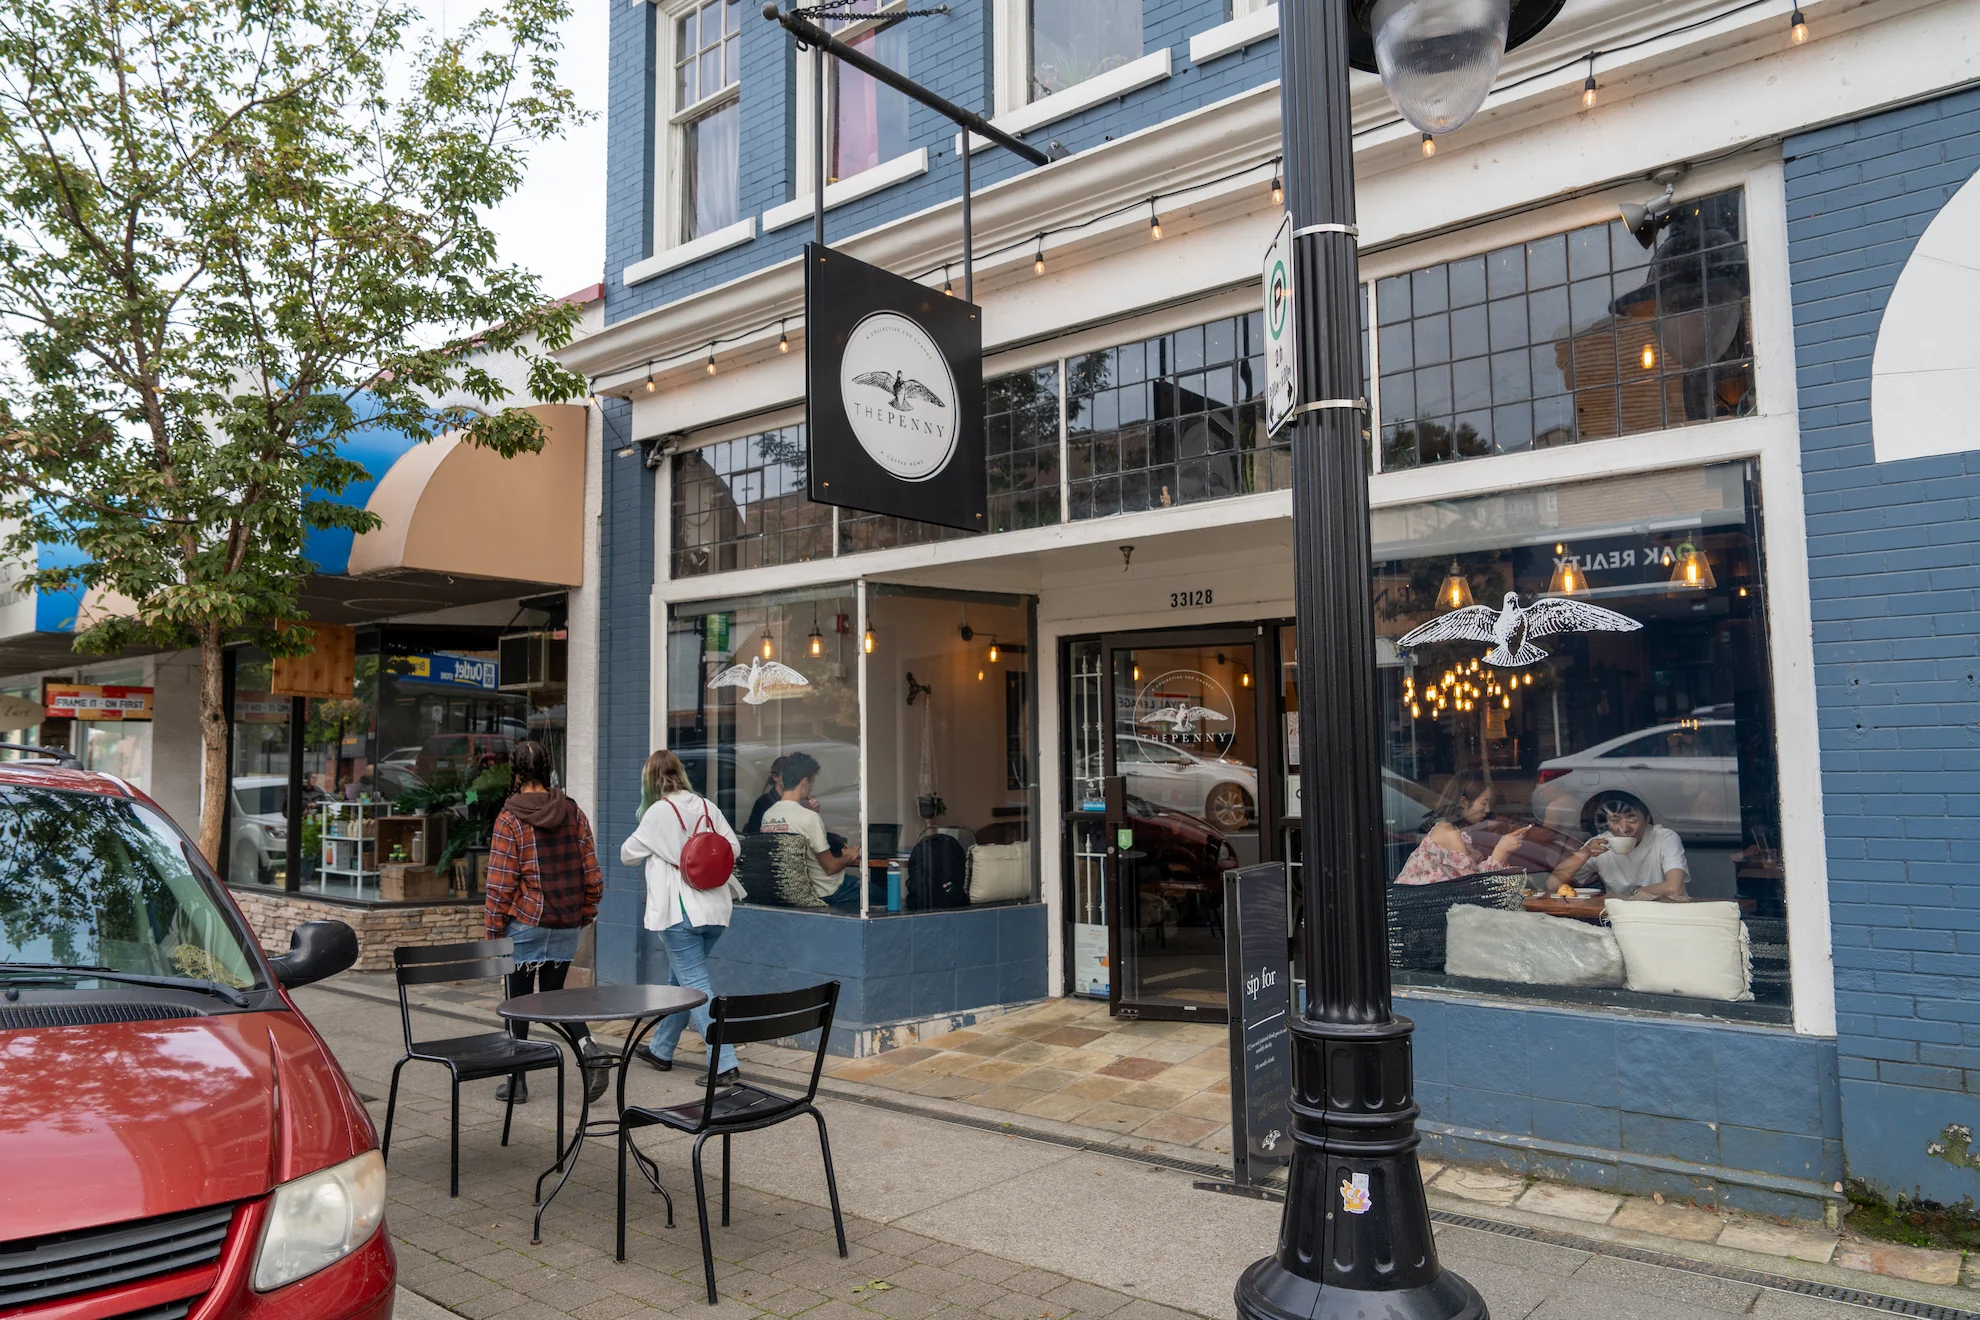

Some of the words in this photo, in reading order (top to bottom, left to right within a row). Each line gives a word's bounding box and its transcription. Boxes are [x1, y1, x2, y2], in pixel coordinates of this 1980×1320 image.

[870, 326, 900, 337] COLLECTIVE
[1170, 589, 1213, 608] 33128
[55, 698, 88, 708] FRAME
[90, 699, 97, 708] IT
[104, 700, 118, 709] ON
[119, 700, 144, 709] FIRST
[1246, 974, 1260, 1001] sip
[1262, 966, 1277, 989] for
